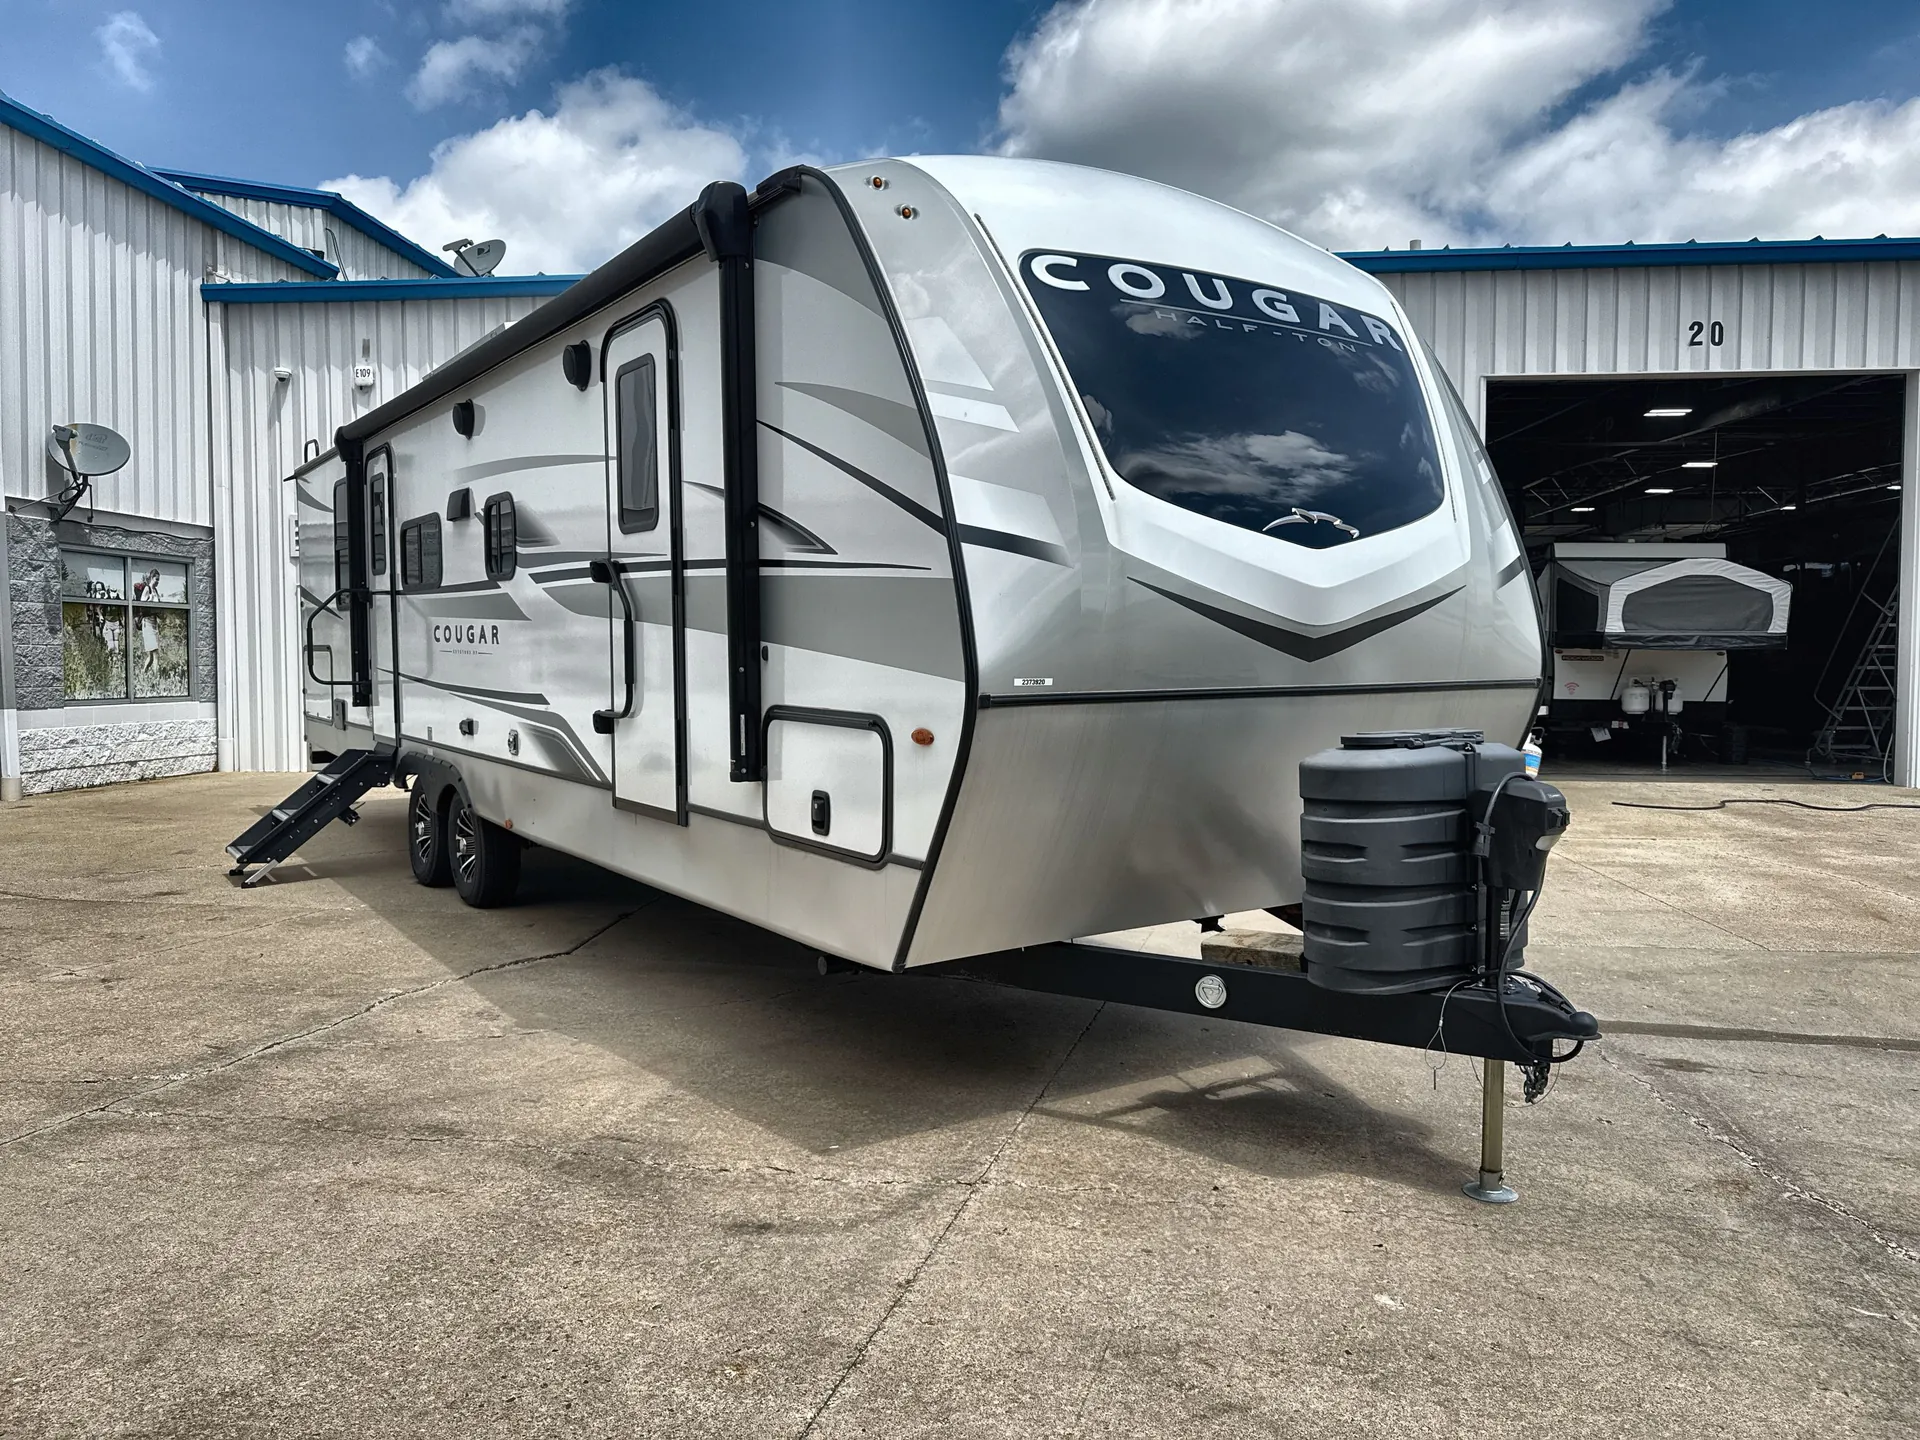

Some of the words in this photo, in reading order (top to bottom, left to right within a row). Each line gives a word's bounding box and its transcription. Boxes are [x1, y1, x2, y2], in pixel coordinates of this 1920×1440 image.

[1030, 254, 1403, 352] COUGAR
[1155, 310, 1357, 353] HALF-TON
[1689, 321, 1723, 346] 20
[355, 368, 371, 378] E109
[433, 624, 500, 645] COUGAR
